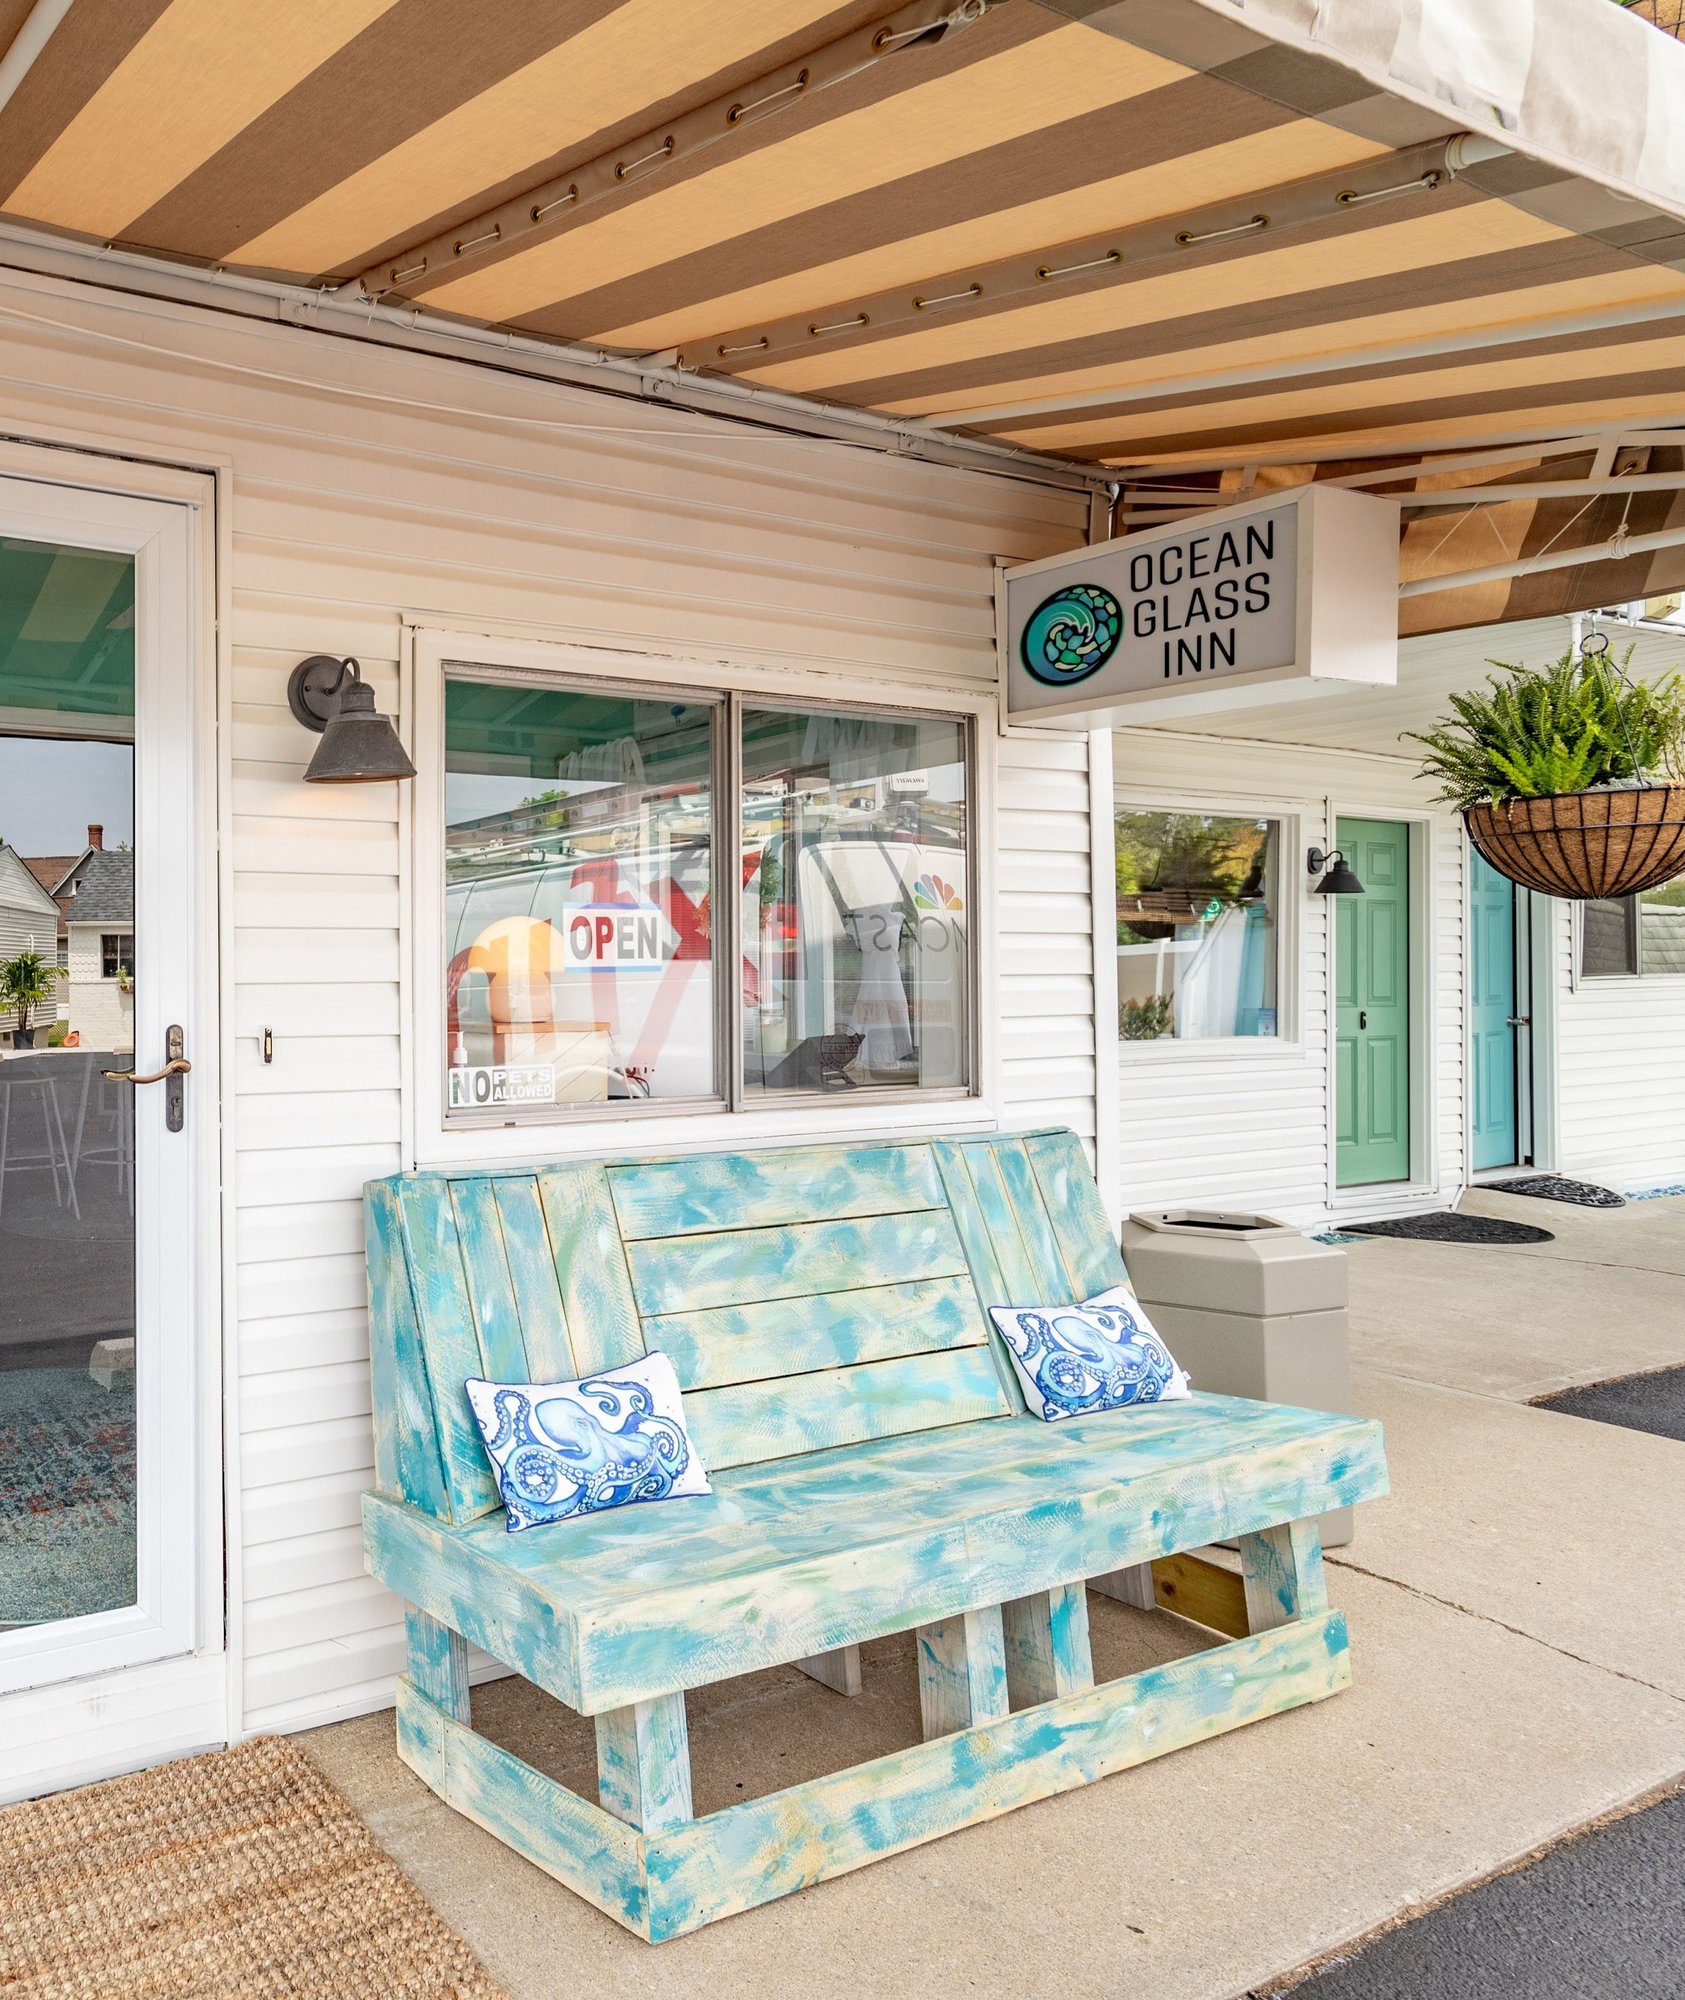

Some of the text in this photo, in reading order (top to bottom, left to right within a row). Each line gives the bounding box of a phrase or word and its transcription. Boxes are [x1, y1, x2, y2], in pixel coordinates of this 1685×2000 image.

[1130, 520, 1274, 593] OCEAN
[1133, 572, 1270, 638] GLASS
[1164, 628, 1236, 678] INN
[569, 915, 658, 960] OPEN
[1359, 1011, 1367, 1030] 6
[452, 1067, 552, 1105] NO PETS
[494, 1083, 551, 1100] ALLOWED
